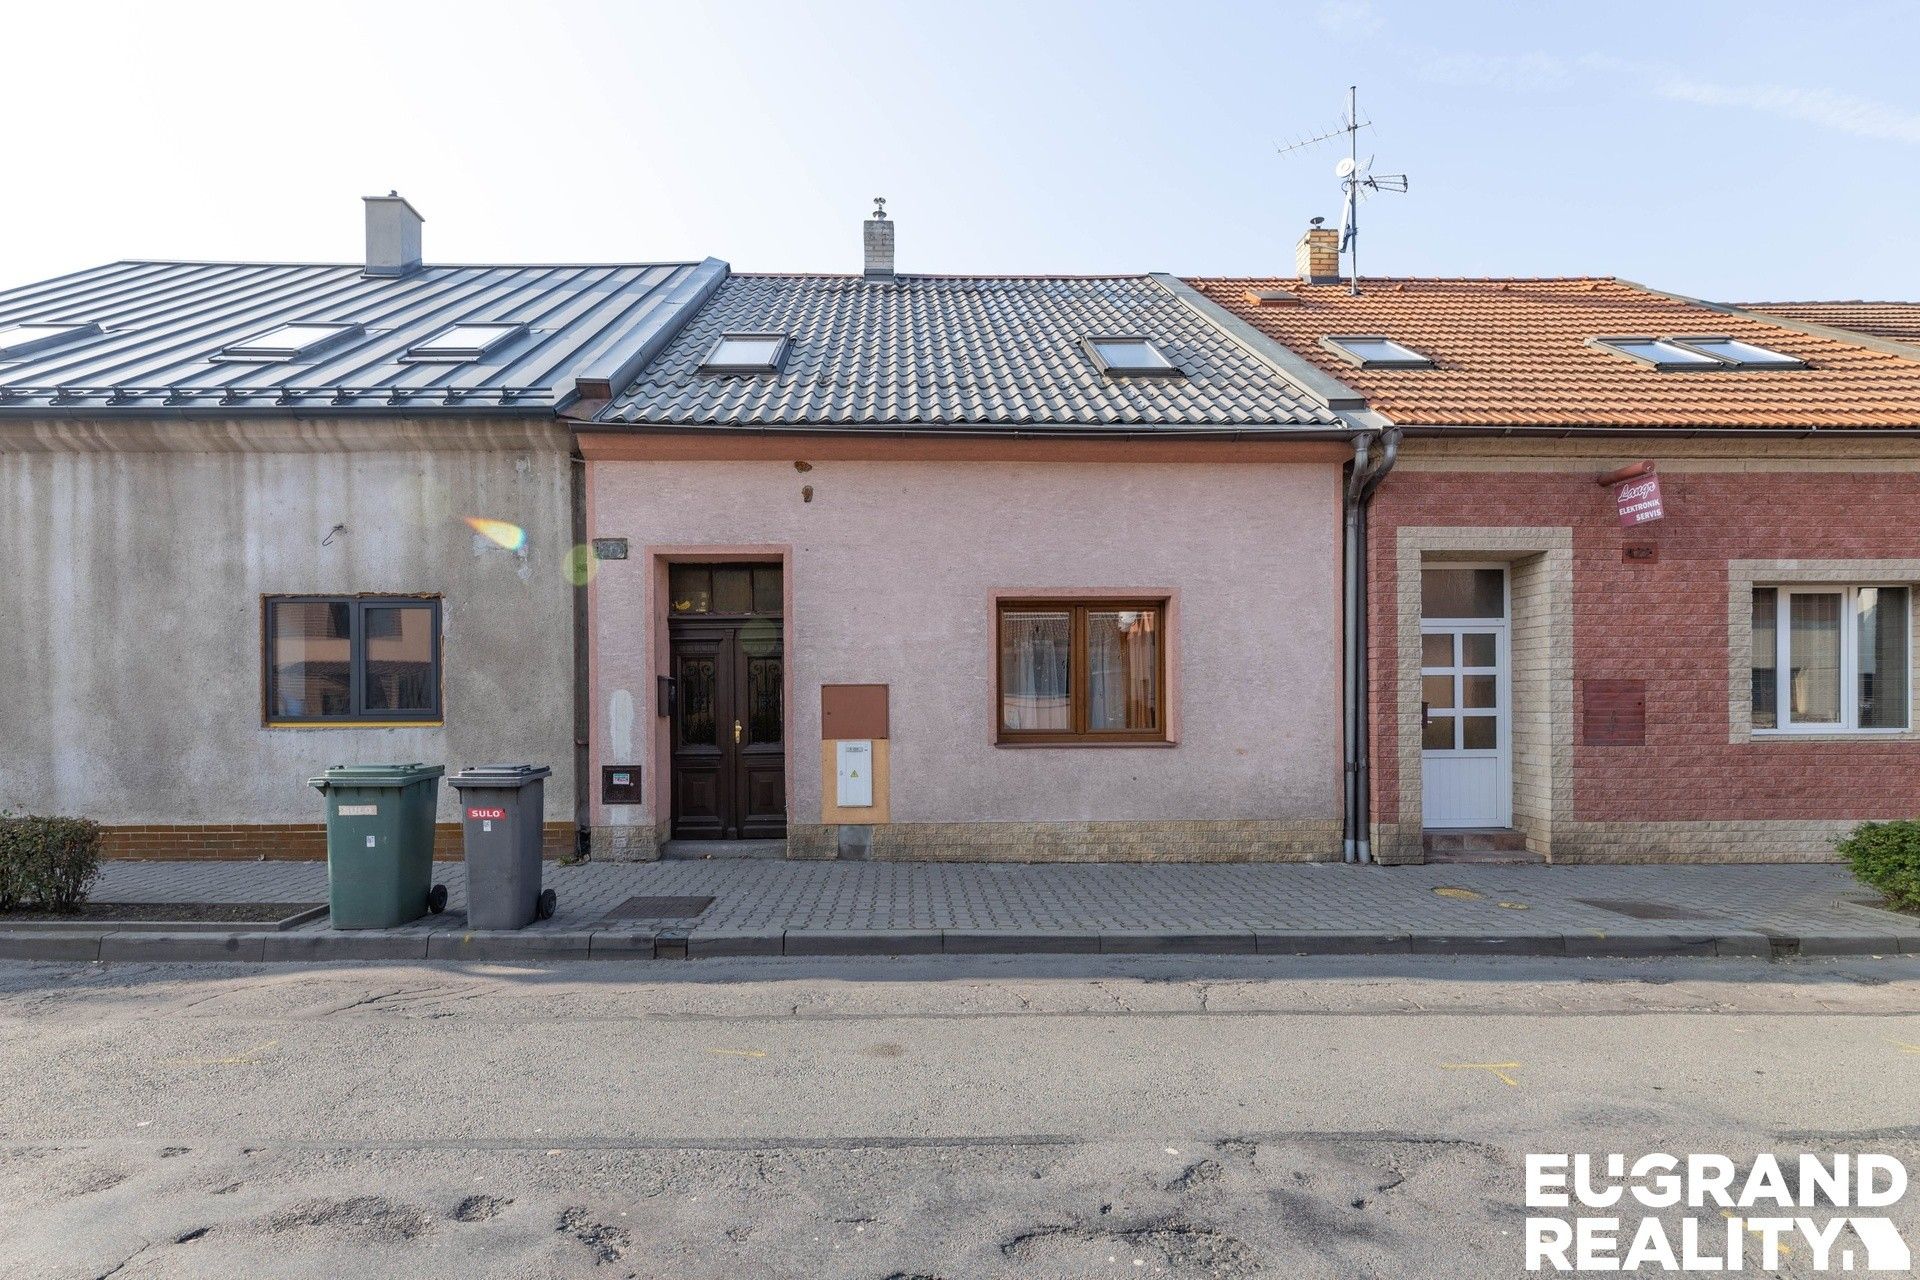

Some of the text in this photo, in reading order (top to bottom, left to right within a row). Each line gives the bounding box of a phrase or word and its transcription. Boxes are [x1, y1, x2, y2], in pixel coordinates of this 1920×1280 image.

[1619, 498, 1660, 515] ELEKTRONIK
[1636, 508, 1661, 521] SERVIS
[471, 809, 500, 818] SULO
